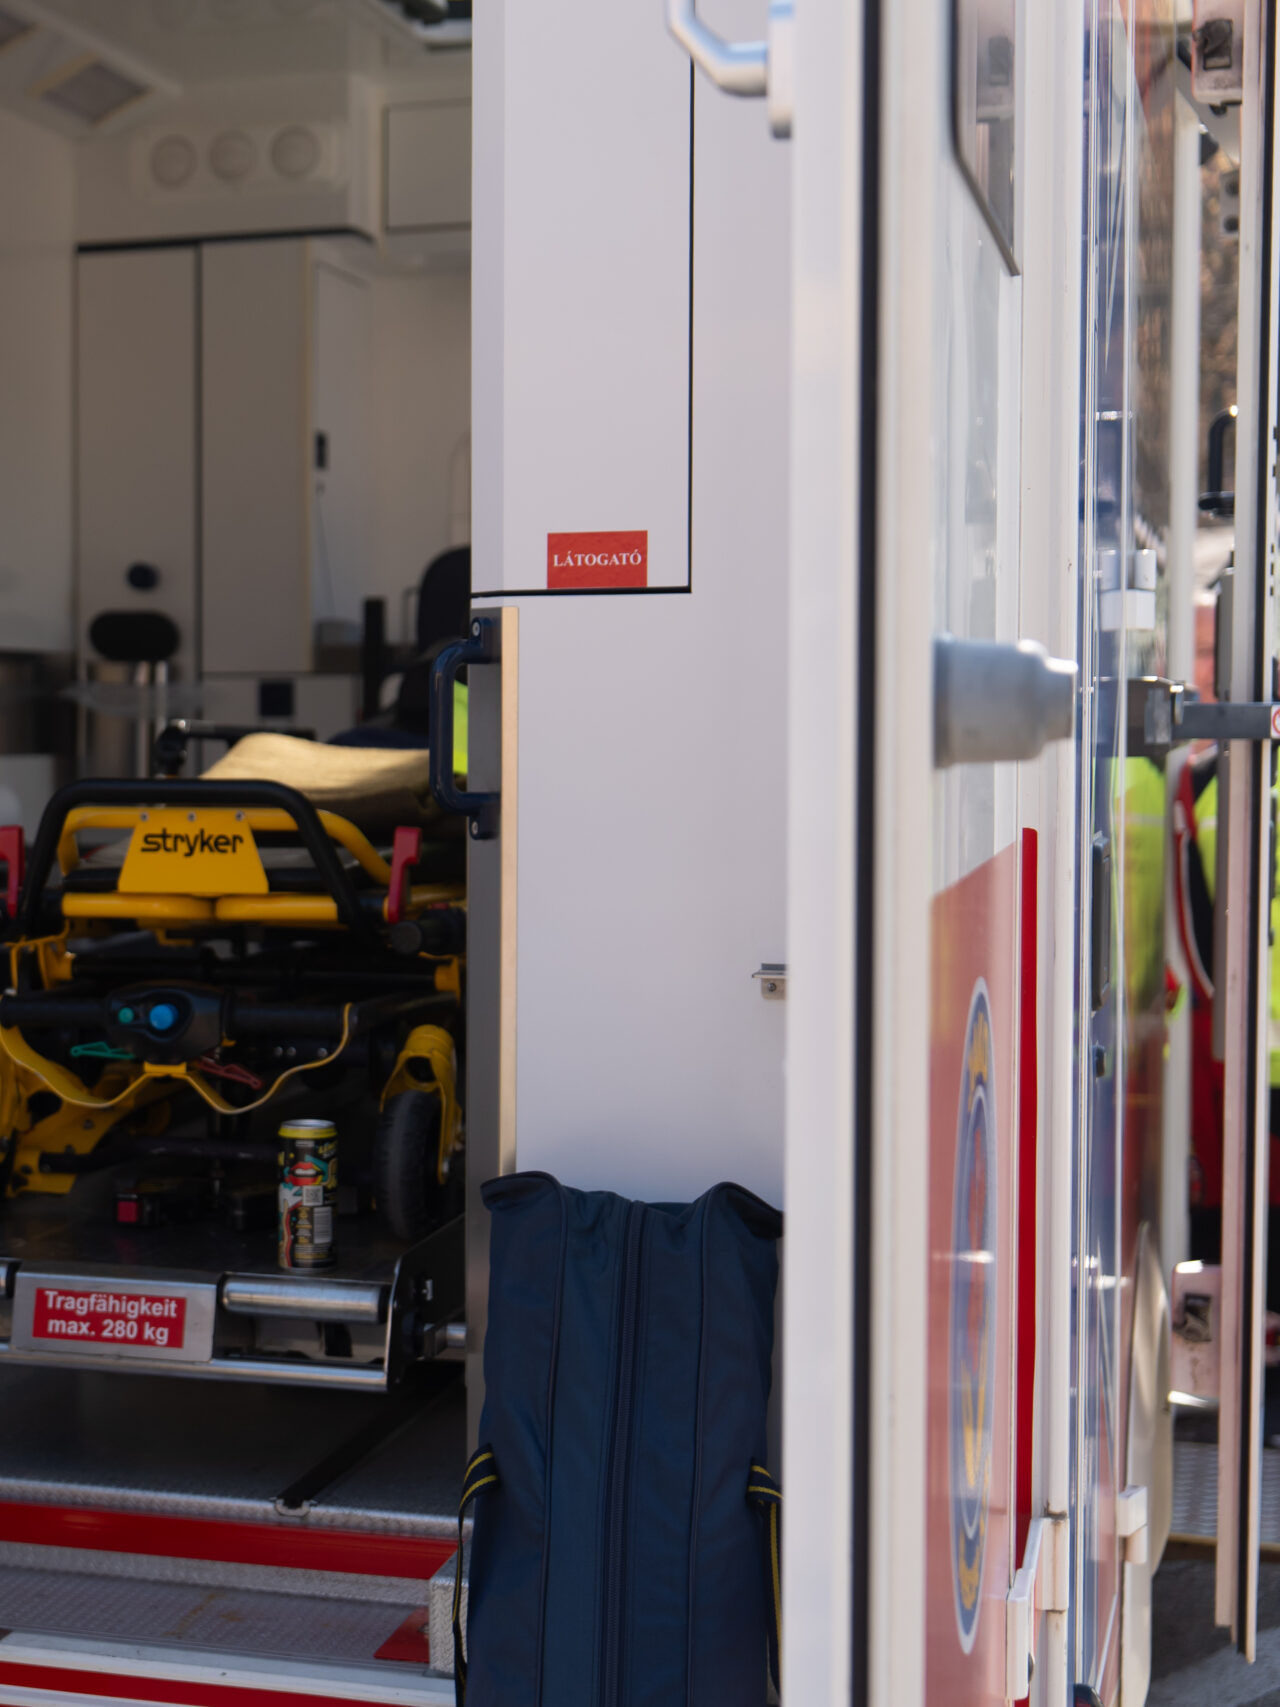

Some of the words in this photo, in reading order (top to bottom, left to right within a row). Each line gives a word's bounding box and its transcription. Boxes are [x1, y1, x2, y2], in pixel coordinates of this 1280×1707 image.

[553, 549, 642, 567] LÁTOGATÓ
[141, 828, 244, 857] stryker
[45, 1290, 177, 1319] Tragfähigkeit
[48, 1319, 96, 1337] max.
[101, 1319, 138, 1339] 280
[143, 1321, 169, 1346] kg
